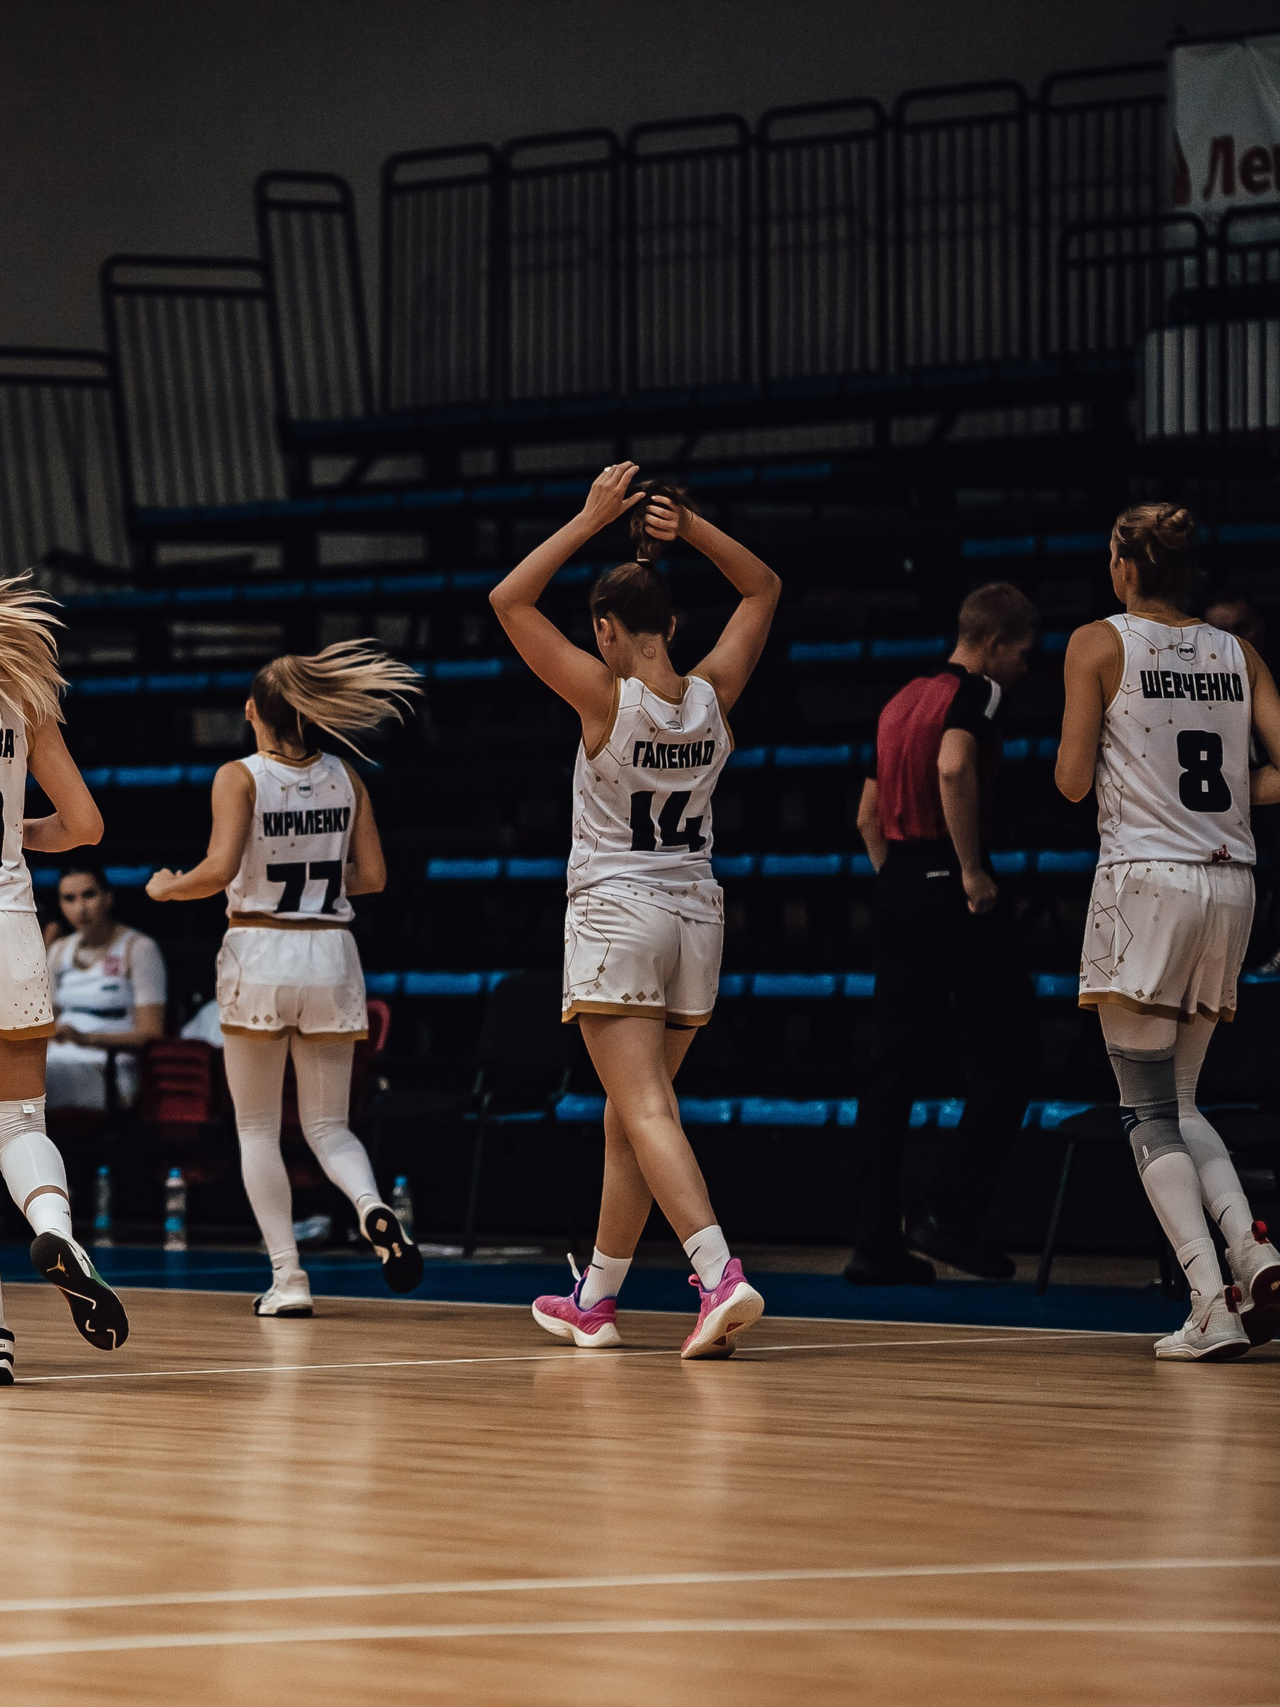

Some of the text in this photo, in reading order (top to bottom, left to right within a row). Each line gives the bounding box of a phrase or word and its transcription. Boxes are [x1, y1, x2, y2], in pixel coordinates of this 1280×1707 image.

[1140, 670, 1244, 701] ШЕВЧЕНКО
[1176, 730, 1232, 812] 8
[630, 790, 707, 853] 14
[266, 860, 342, 914] 77
